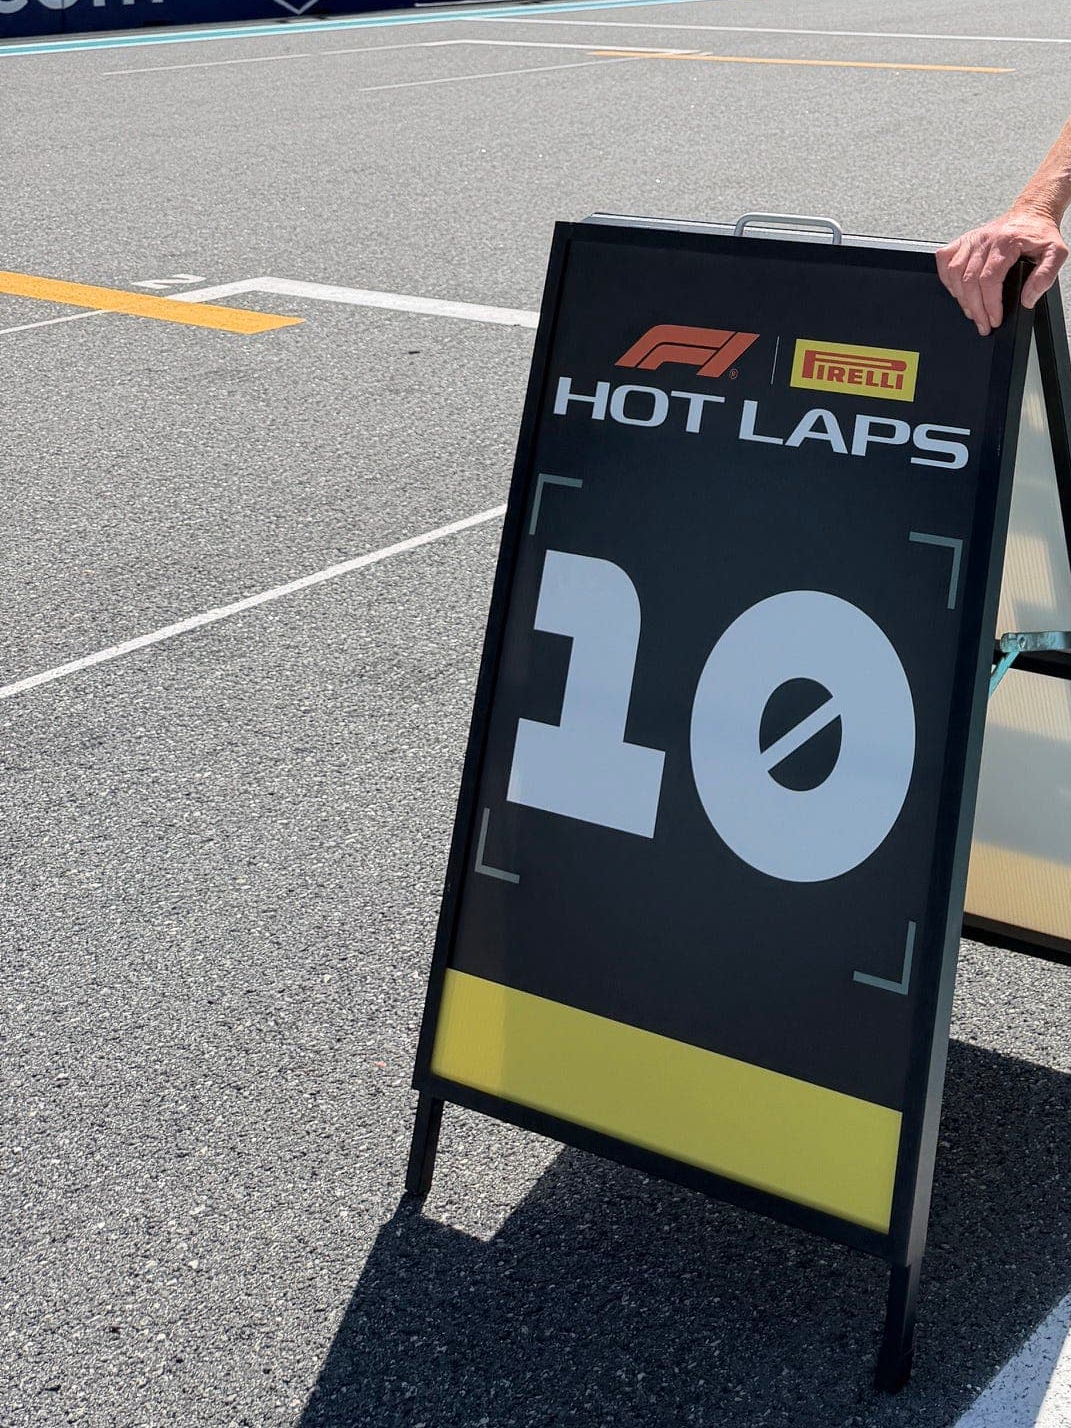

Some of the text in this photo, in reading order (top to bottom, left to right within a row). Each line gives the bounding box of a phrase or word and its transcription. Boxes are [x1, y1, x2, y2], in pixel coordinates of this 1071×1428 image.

[801, 349, 908, 390] PIRELLI
[553, 376, 971, 470] HOT LAPS
[506, 549, 916, 883] 10
